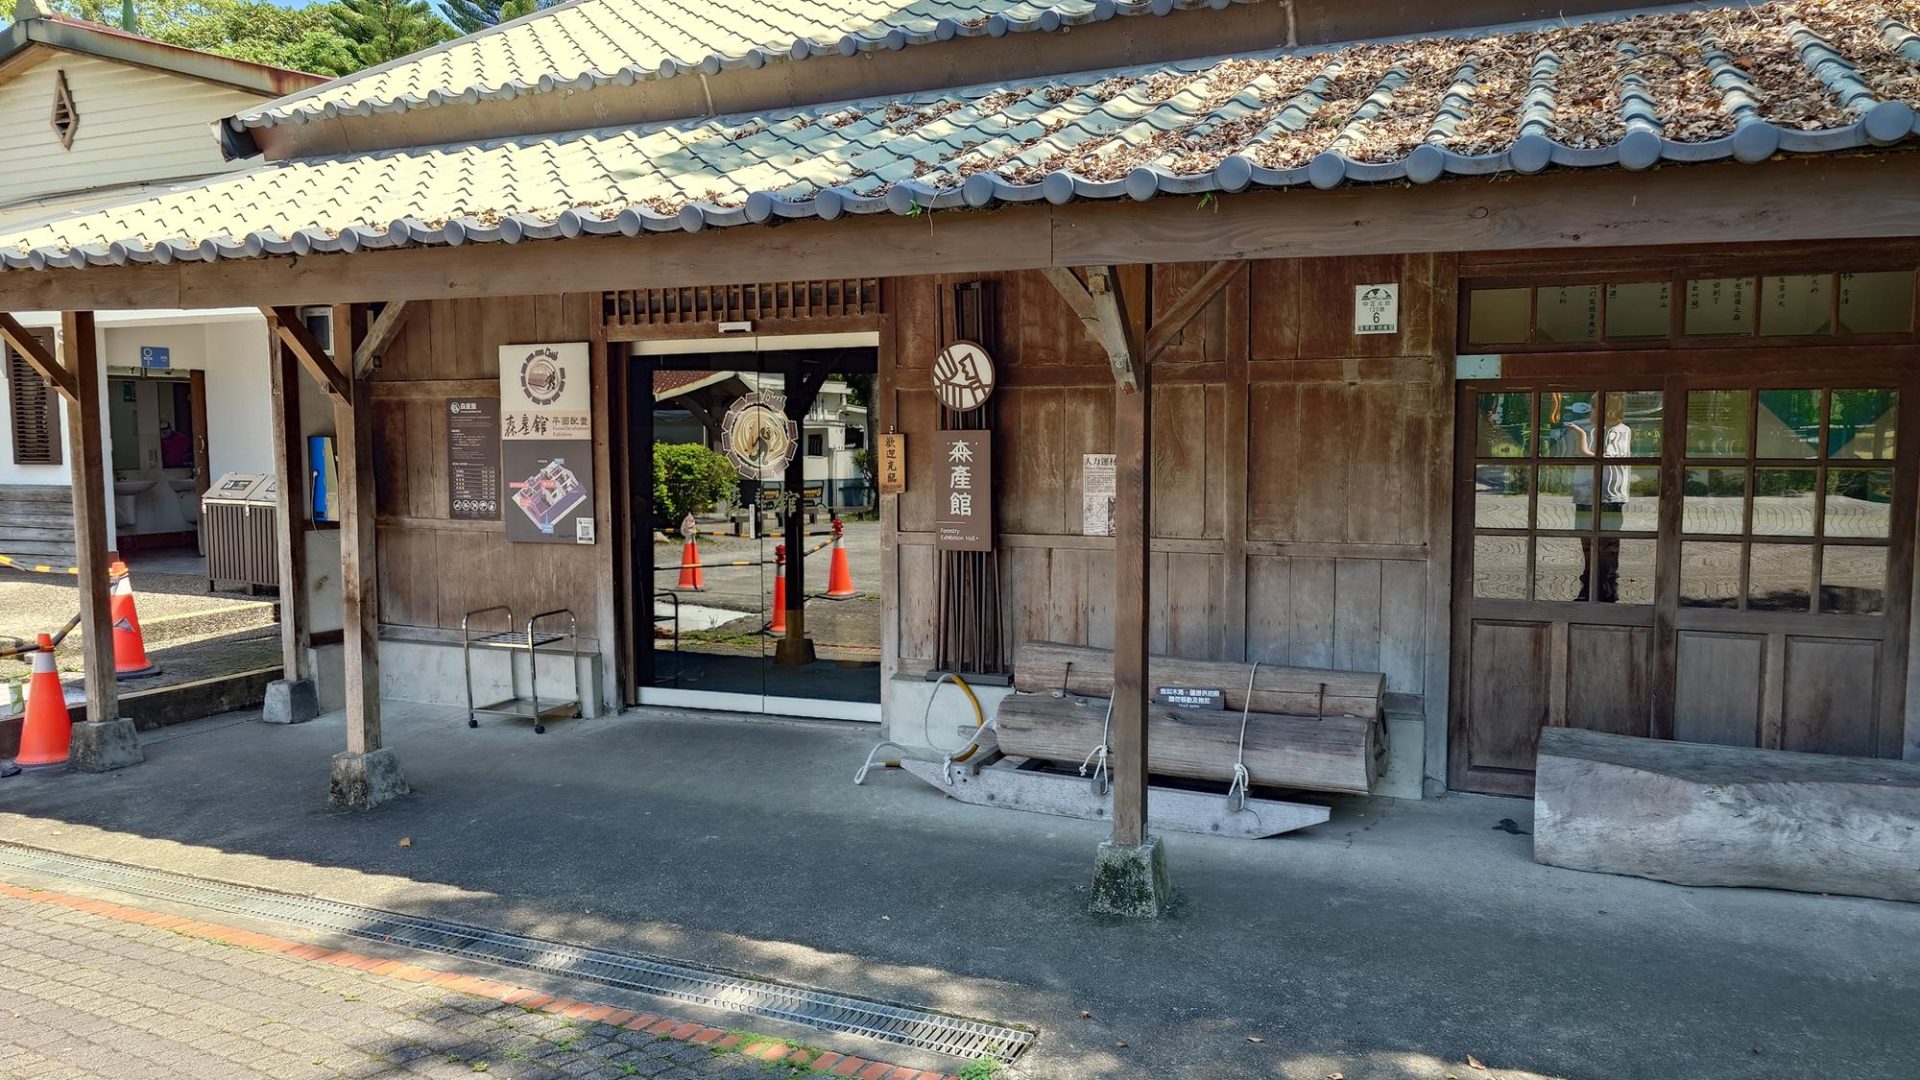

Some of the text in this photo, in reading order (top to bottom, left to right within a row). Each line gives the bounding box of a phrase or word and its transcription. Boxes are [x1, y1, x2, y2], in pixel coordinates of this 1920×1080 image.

[1373, 312, 1380, 324] 6
[552, 416, 589, 426] 平面配置
[948, 439, 973, 517] 森產館
